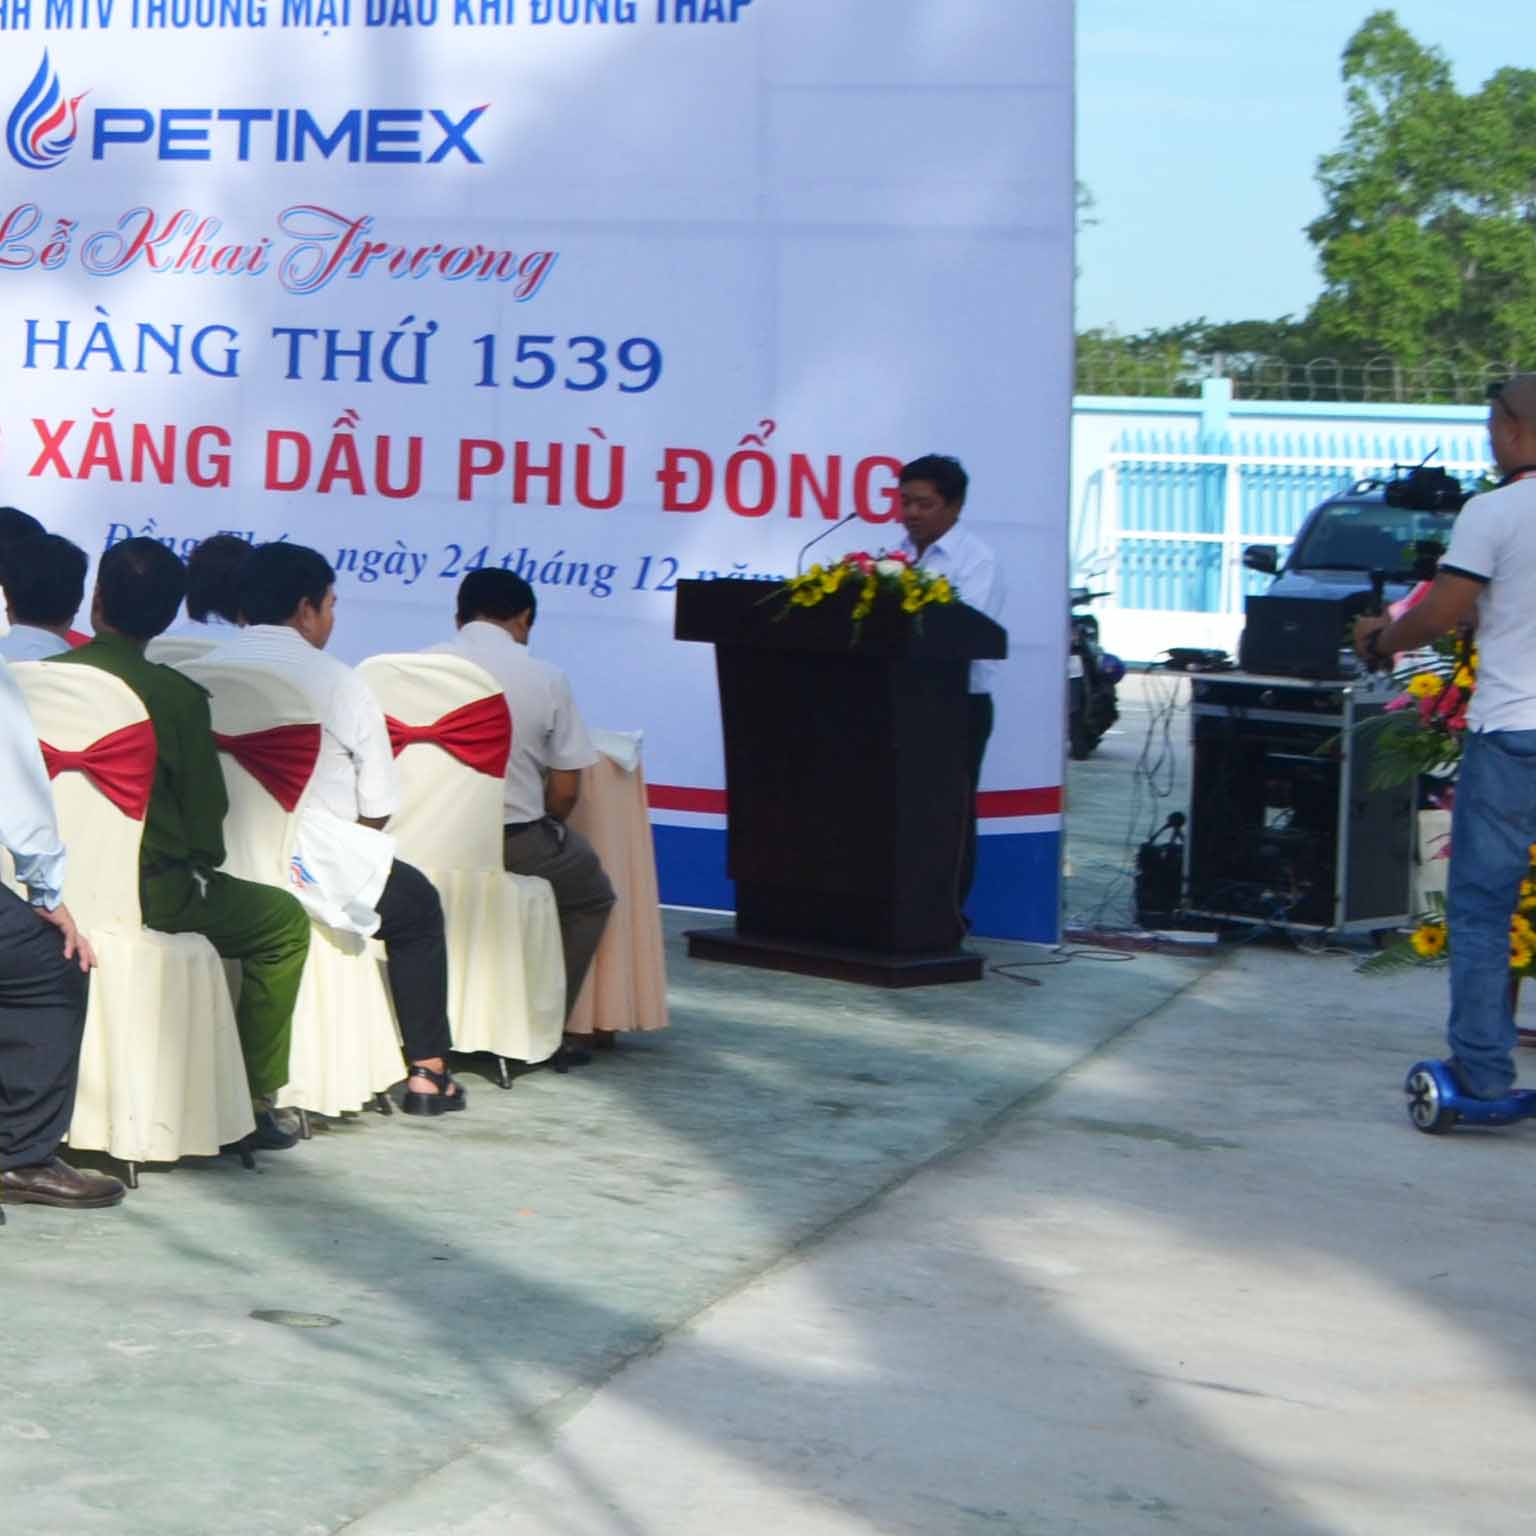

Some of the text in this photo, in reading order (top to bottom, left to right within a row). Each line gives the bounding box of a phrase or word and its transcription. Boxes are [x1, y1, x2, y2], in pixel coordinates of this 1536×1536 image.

[92, 103, 492, 164] PETIMEX
[80, 206, 272, 276] Khai
[277, 204, 559, 302] Trương
[22, 305, 240, 378] HÀNG
[272, 315, 438, 386] THỨ
[472, 332, 663, 393] 1539
[27, 407, 232, 487] XĂNG
[264, 408, 423, 498] DẦU
[456, 427, 626, 511] PHÙ
[655, 419, 904, 525] ĐỔNG
[335, 540, 428, 585] ngày
[438, 544, 490, 579] 24
[500, 547, 617, 598] tháng
[632, 555, 679, 591] 12
